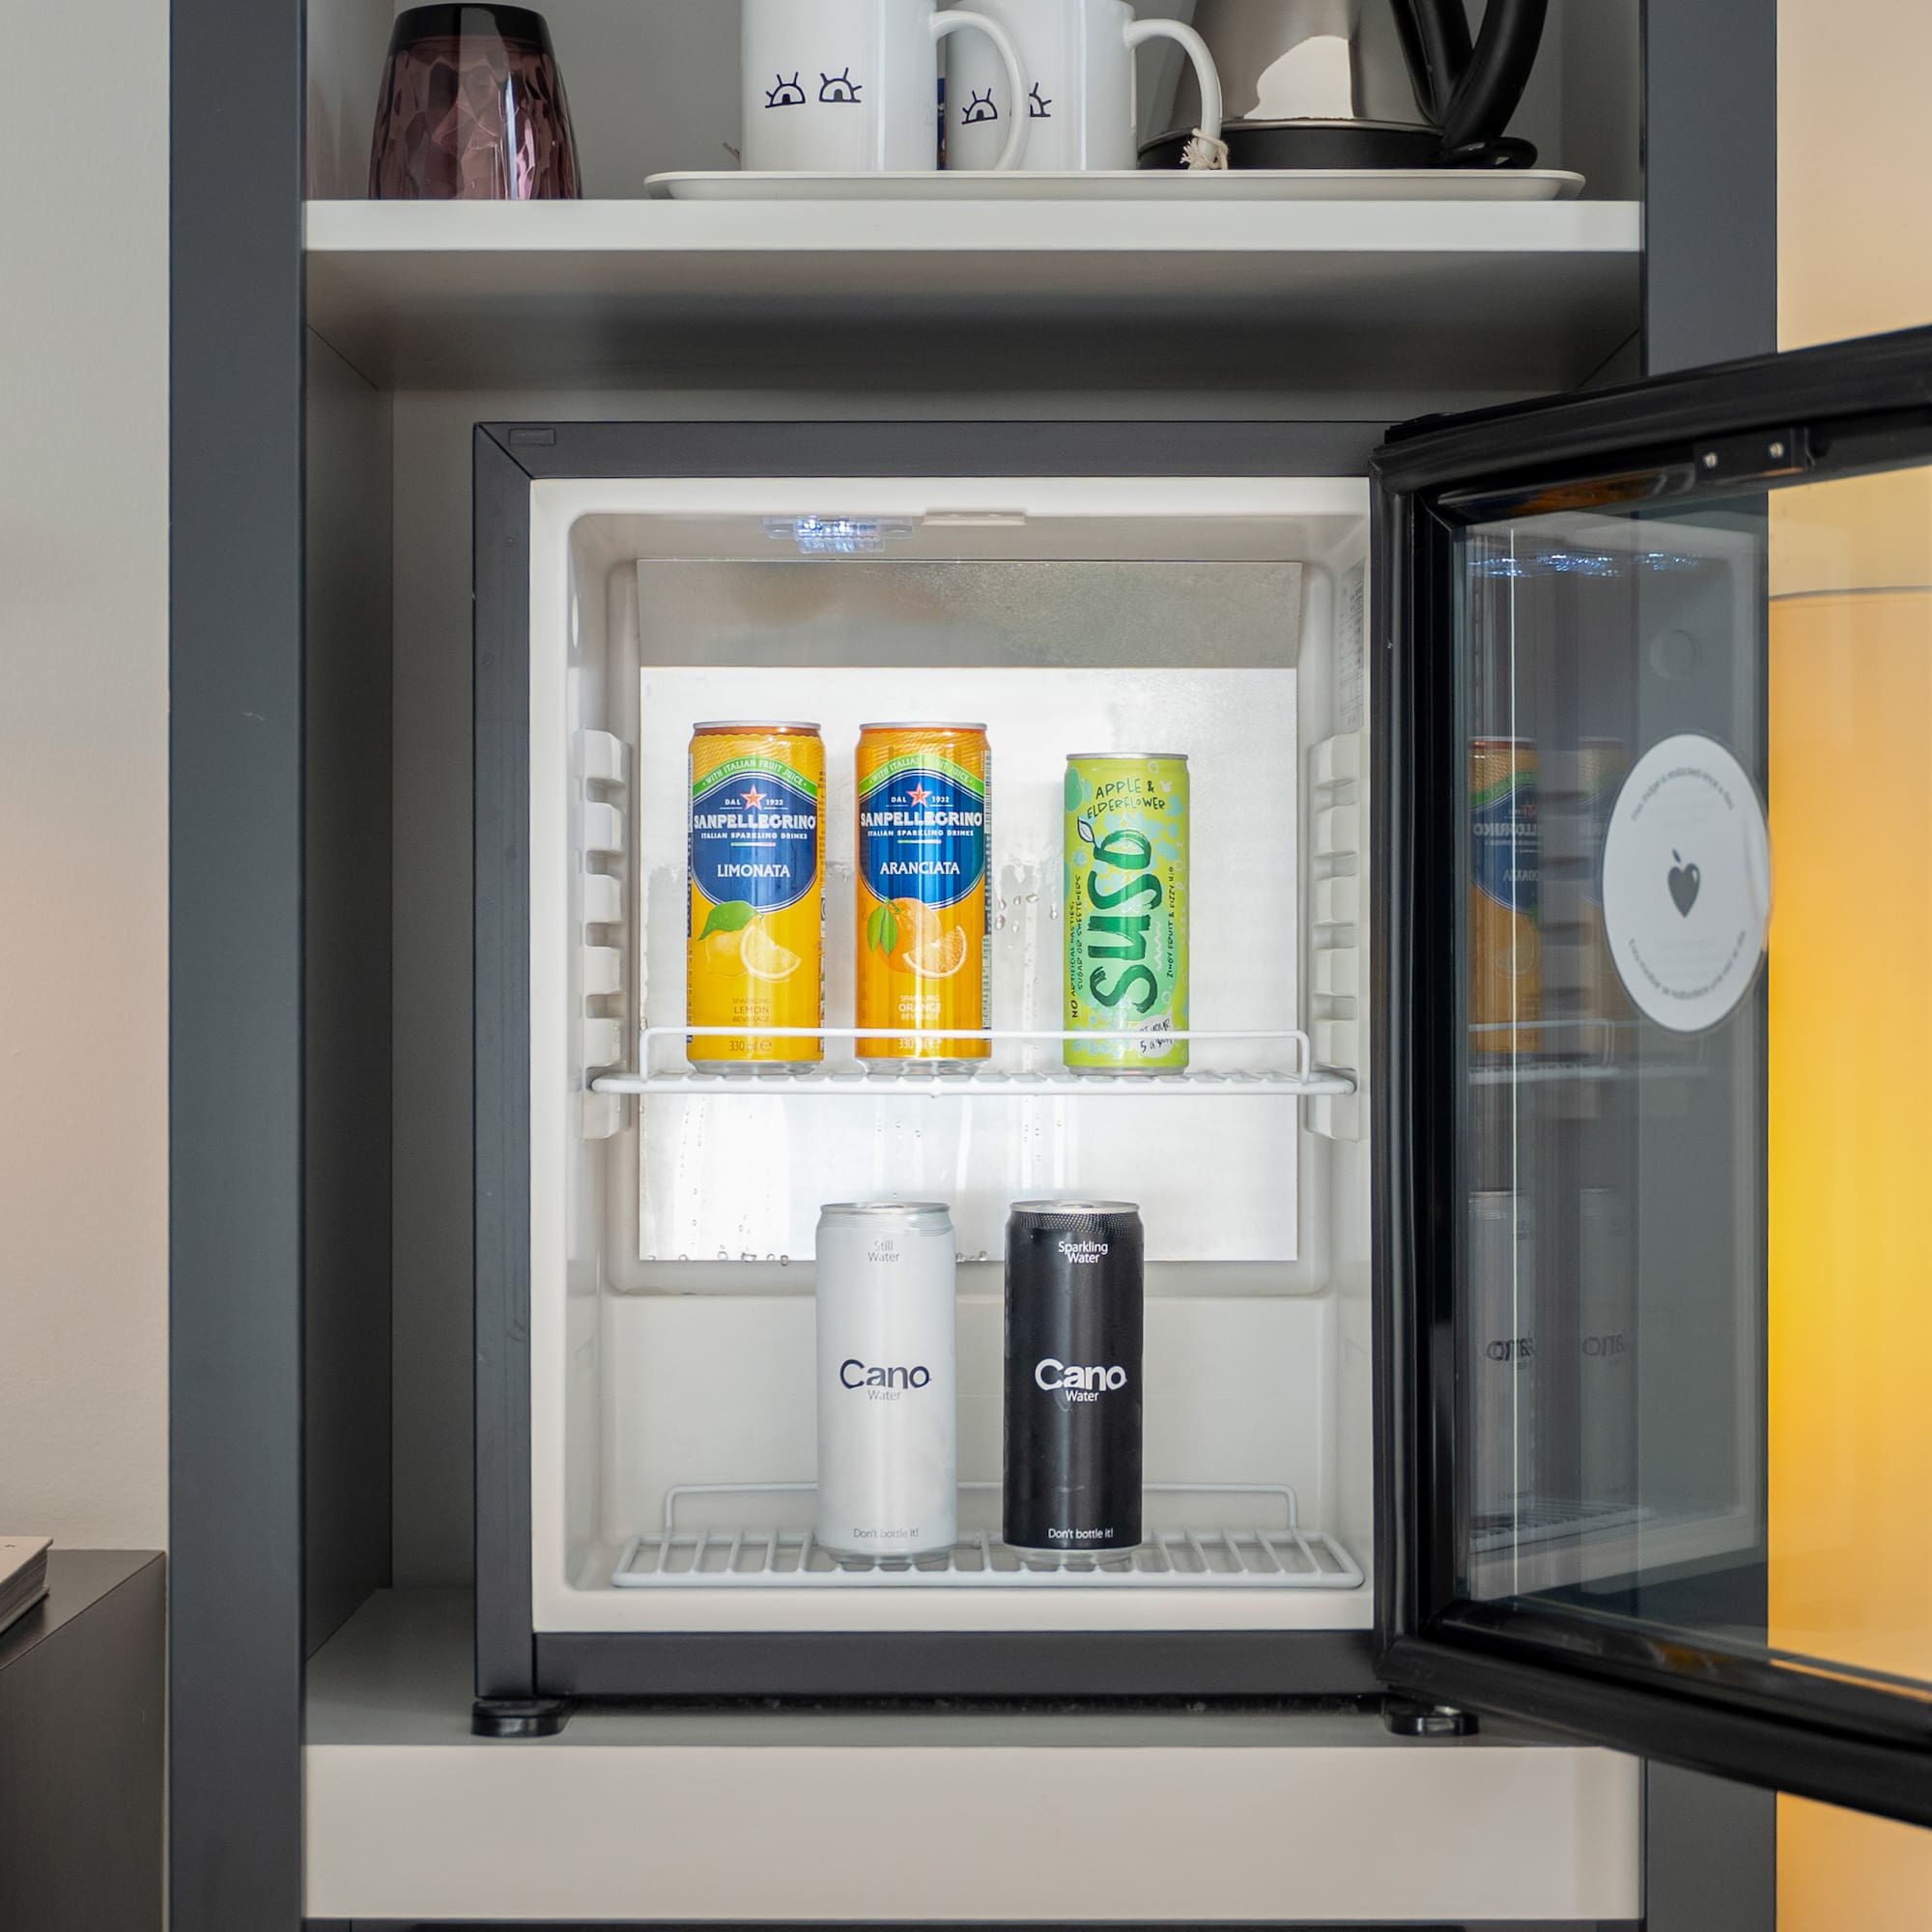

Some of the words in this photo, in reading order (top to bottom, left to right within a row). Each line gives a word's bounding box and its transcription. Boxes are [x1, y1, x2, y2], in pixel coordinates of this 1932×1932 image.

[923, 756, 949, 770] UIT
[705, 768, 724, 783] WITH
[724, 758, 756, 774] ITALIAN
[759, 758, 782, 772] FRUIT
[783, 766, 804, 785] JUICE
[1095, 777, 1142, 800] APPLE
[1147, 781, 1154, 793] &
[1087, 797, 1165, 819] ELDERFLOWER
[694, 814, 816, 830] SANPELLEGRINO
[861, 810, 982, 827] SANPELLEGRINO
[717, 863, 791, 878] LIMONATA
[880, 862, 960, 875] ARANCIATA
[1087, 829, 1163, 1014] SUSO
[898, 1003, 941, 1012] ORNGE
[1070, 1000, 1078, 1018] NO
[728, 1040, 745, 1051] 330
[874, 1240, 893, 1251] Still
[1058, 1240, 1108, 1255] Sparkling
[867, 1252, 899, 1262] Water
[1067, 1253, 1100, 1264] Water
[839, 1359, 931, 1389] Cano
[1035, 1358, 1126, 1391] Cano
[867, 1390, 901, 1401] Water
[1065, 1390, 1099, 1402] Water
[1075, 1528, 1103, 1539] bottle
[1104, 1527, 1114, 1539] it!
